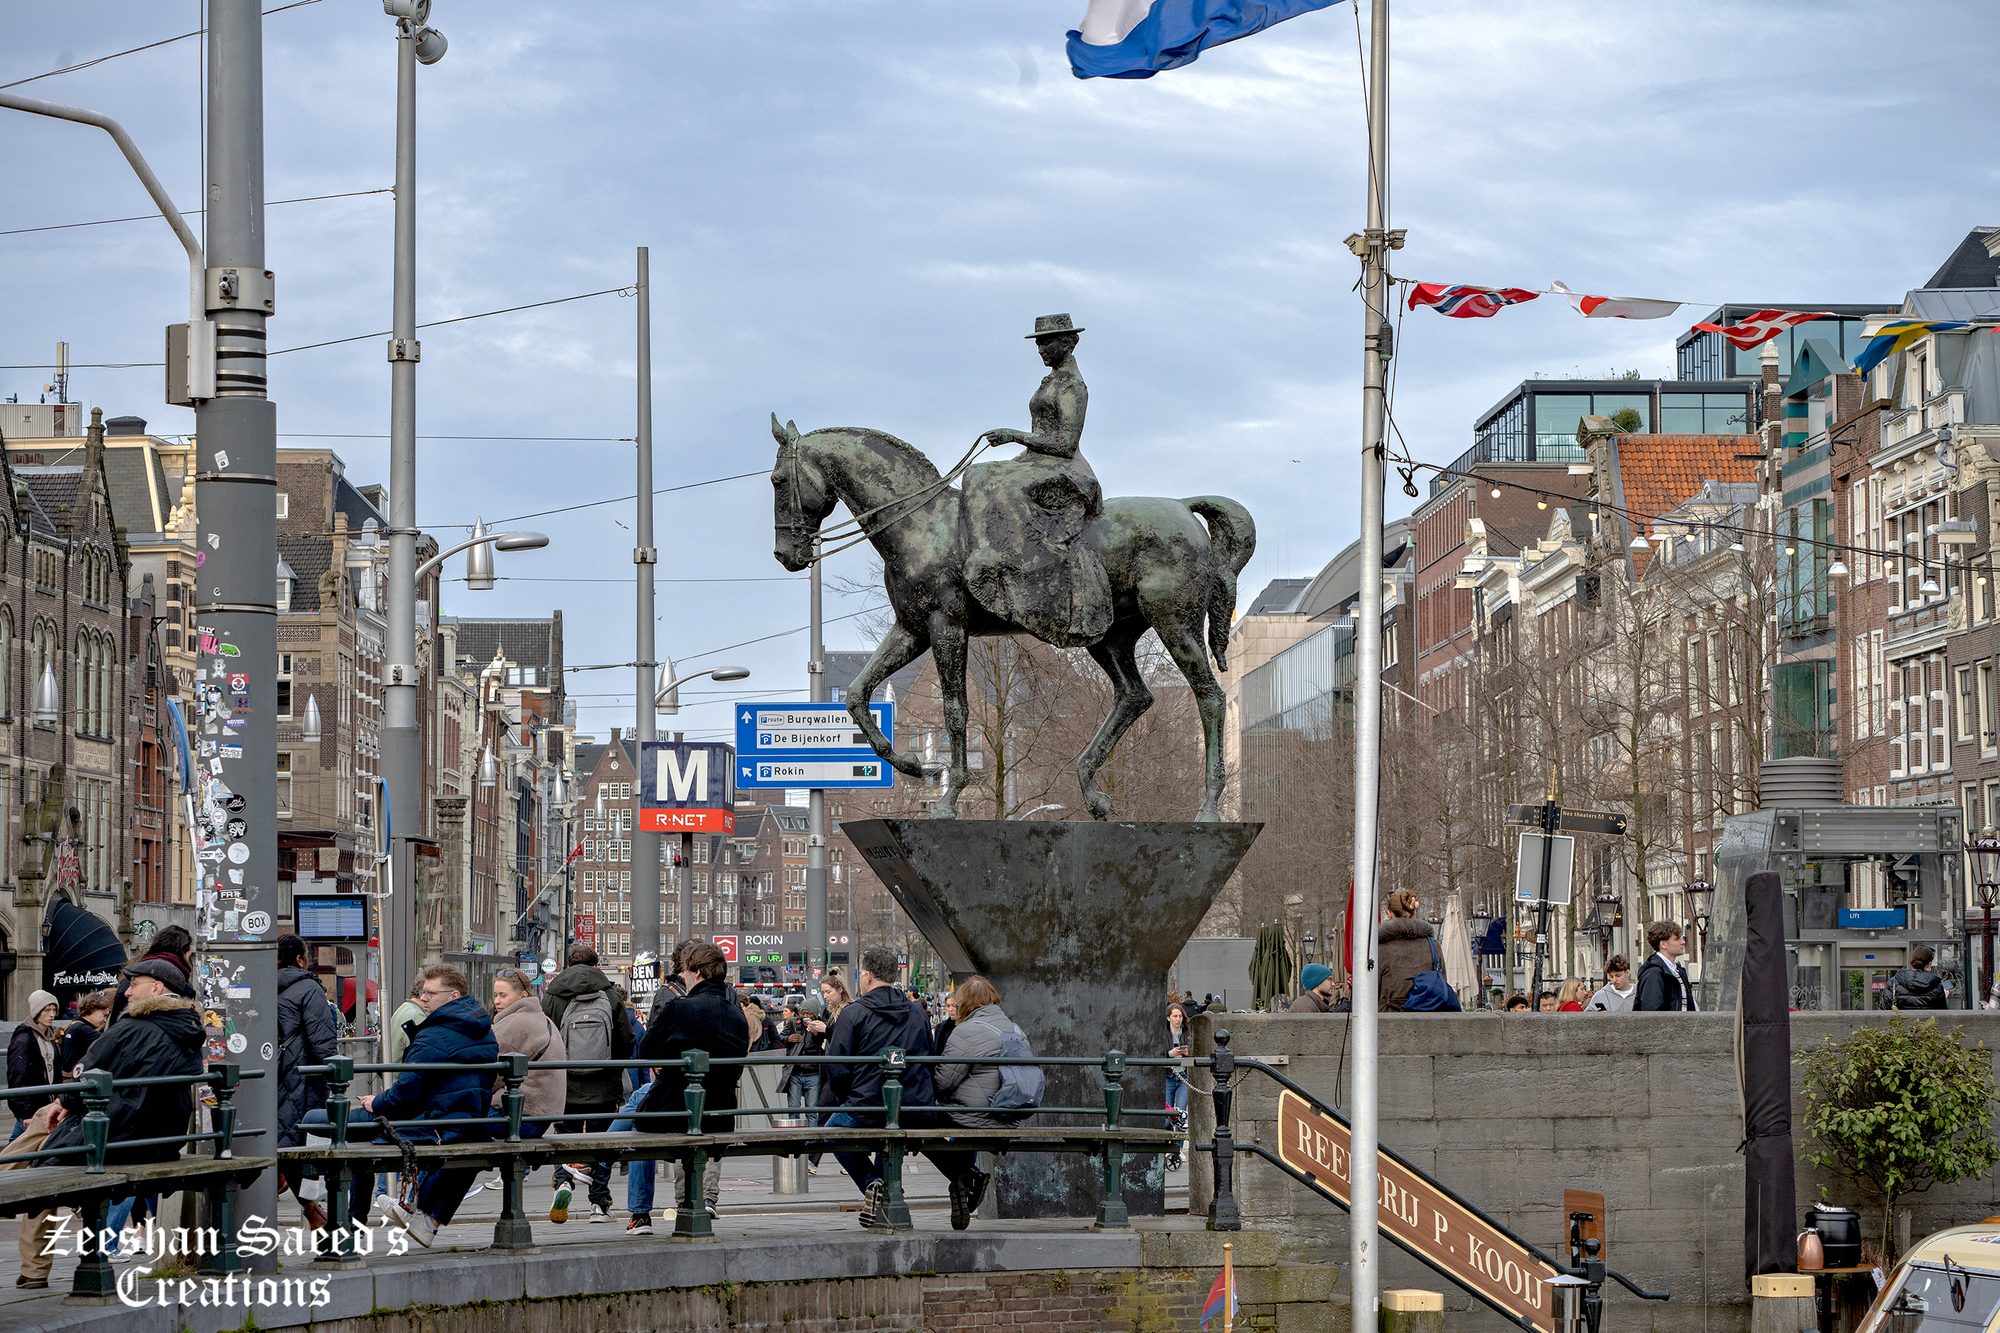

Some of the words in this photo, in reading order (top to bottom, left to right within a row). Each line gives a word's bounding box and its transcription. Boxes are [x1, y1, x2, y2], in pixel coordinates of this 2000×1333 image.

[787, 714, 848, 726] Burgwallen
[774, 734, 788, 743] De
[791, 733, 841, 745] Bijenkorf
[656, 749, 708, 801] M
[774, 766, 804, 776] Rokin
[248, 916, 266, 929] BOX
[745, 934, 784, 945] ROKIN
[53, 970, 73, 987] Fear
[632, 965, 655, 979] BEN
[1296, 1117, 1420, 1228] REERIJ
[1433, 1208, 1455, 1254] P.
[1467, 1232, 1546, 1311] KOOIJ
